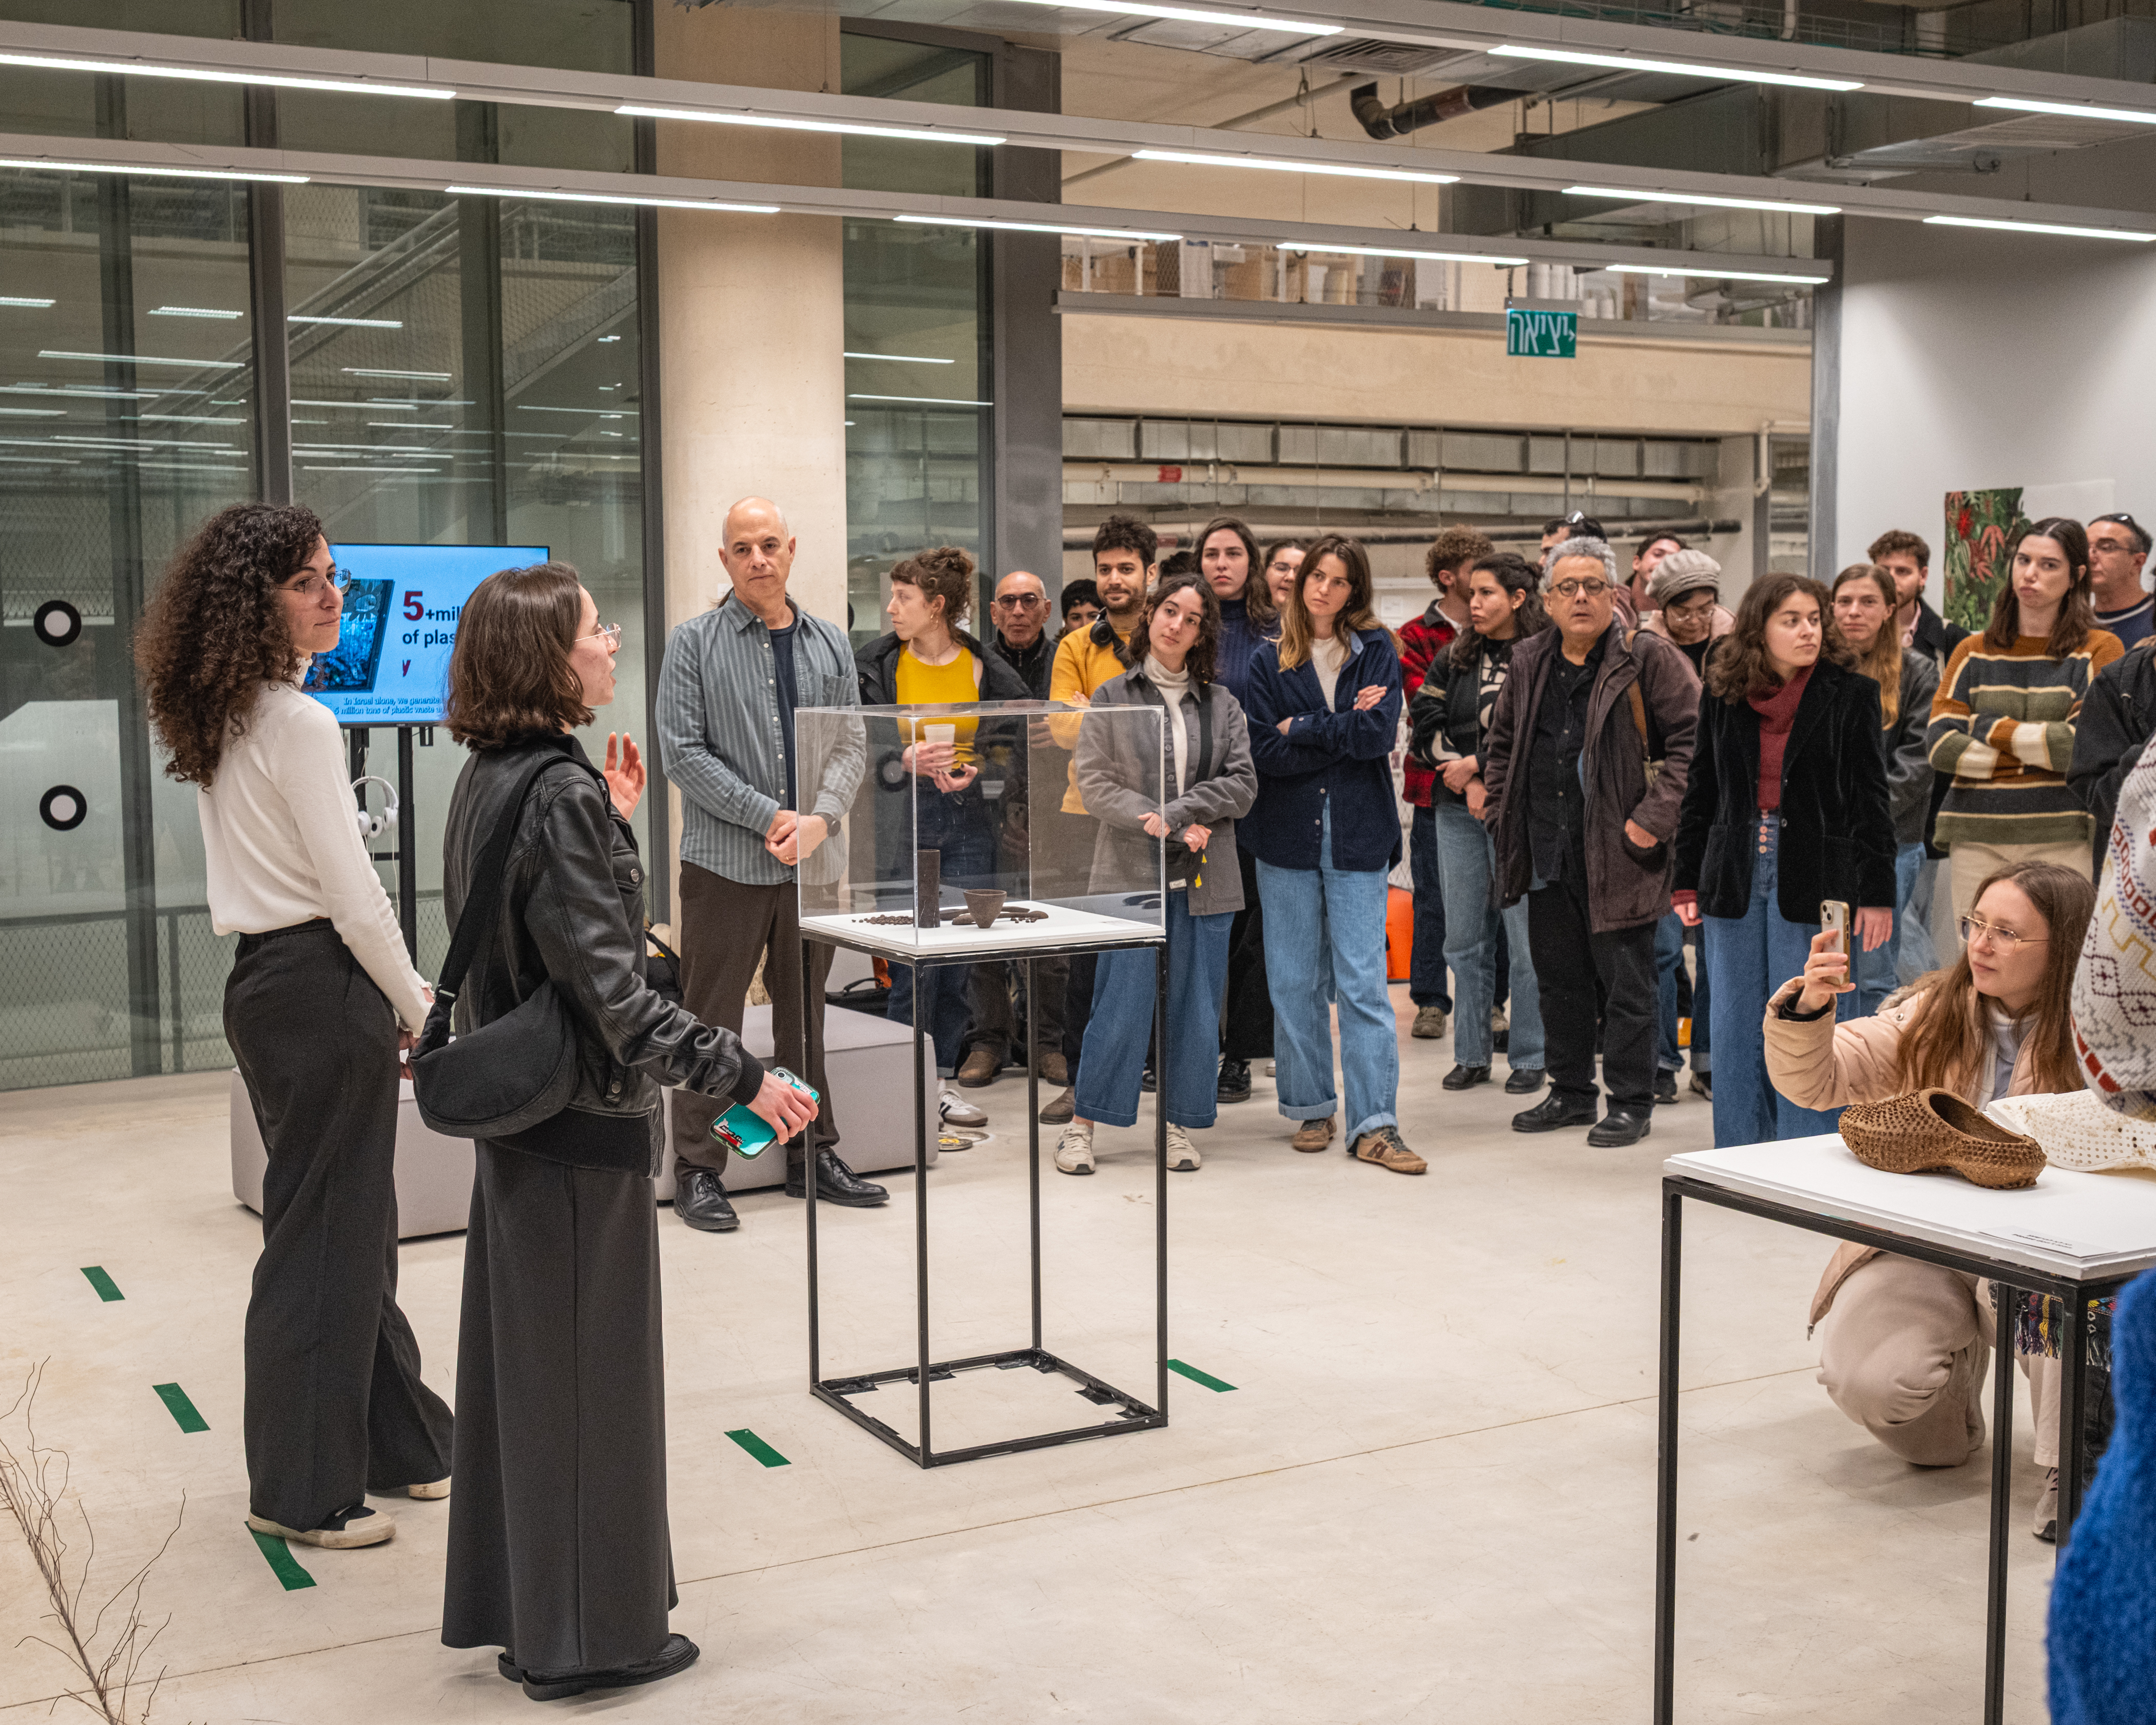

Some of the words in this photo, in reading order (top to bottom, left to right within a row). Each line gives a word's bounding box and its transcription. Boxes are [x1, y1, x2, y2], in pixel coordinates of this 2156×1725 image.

[1510, 313, 1569, 355] יציאה
[402, 590, 465, 621] 5+mil
[402, 629, 419, 644] of
[353, 697, 373, 705] Israel
[375, 697, 395, 706] alone,
[410, 697, 440, 705] generate
[392, 706, 413, 715] plastic
